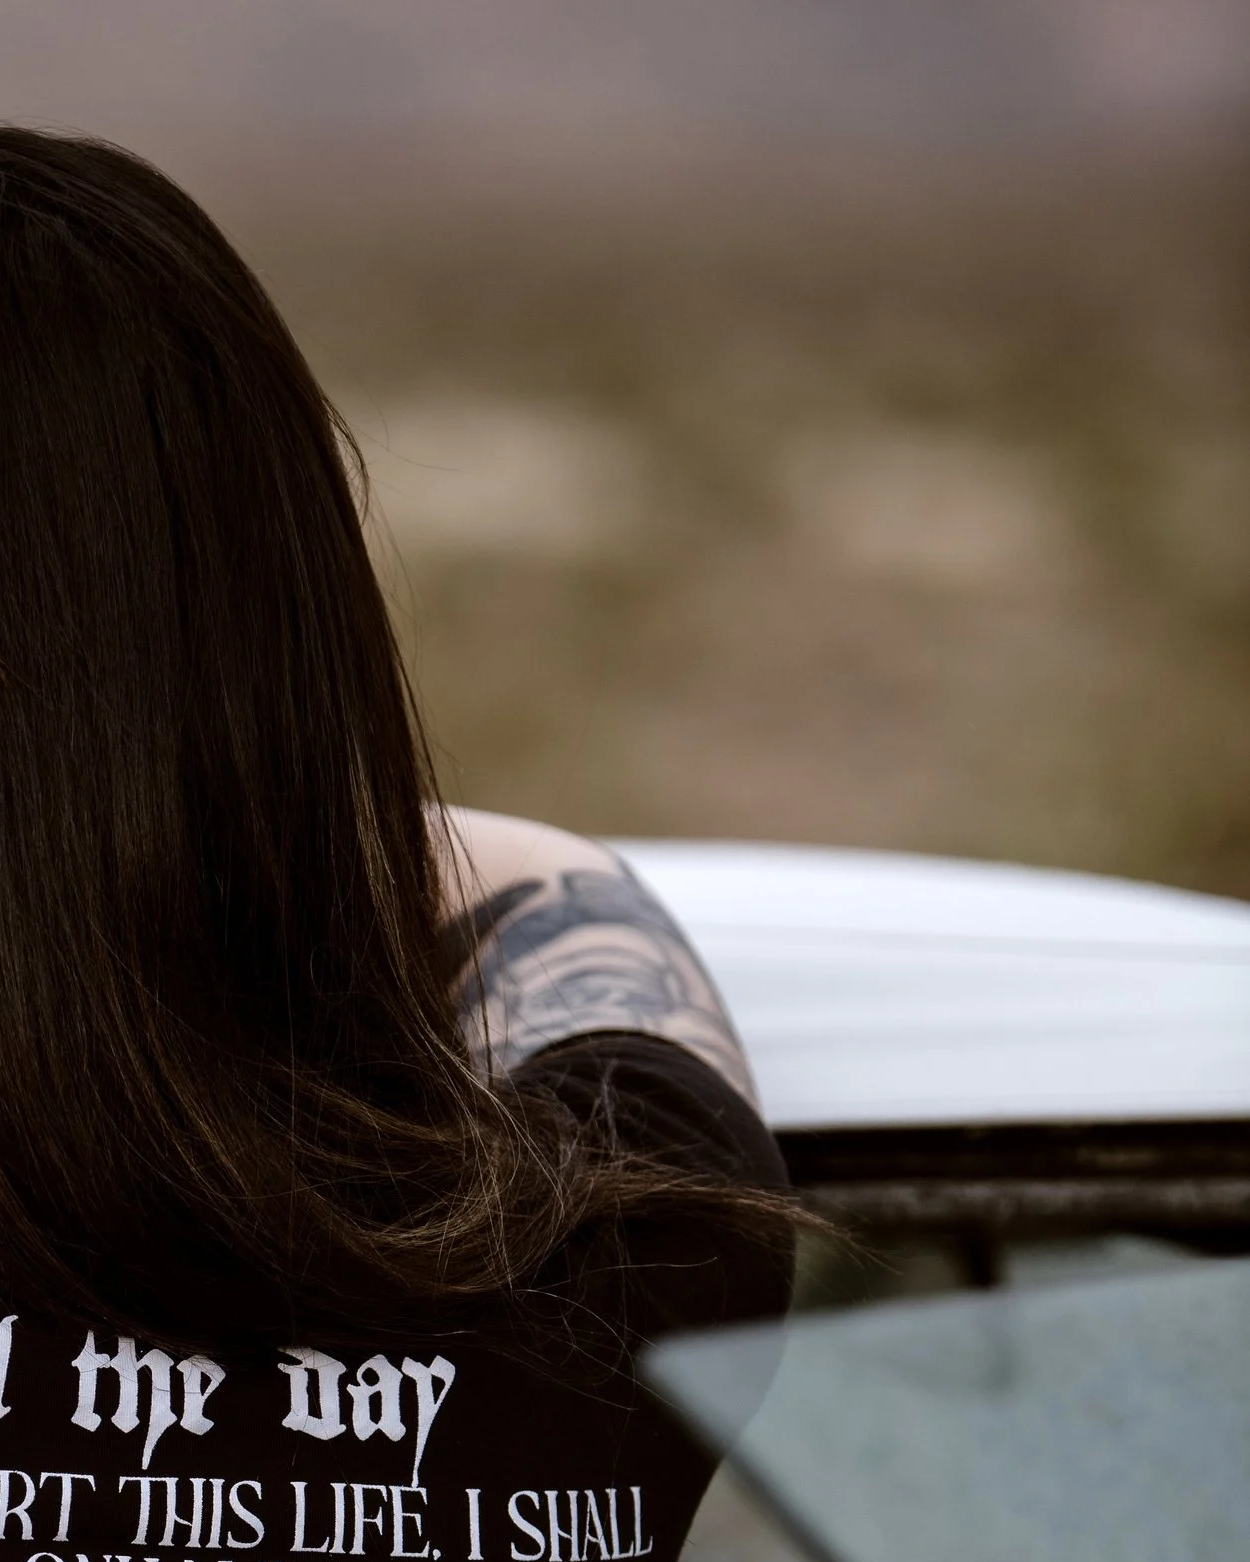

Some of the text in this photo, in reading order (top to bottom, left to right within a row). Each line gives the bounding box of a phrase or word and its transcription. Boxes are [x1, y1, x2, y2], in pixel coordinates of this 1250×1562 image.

[70, 1330, 228, 1471] the
[119, 1476, 264, 1548] THIS
[290, 1481, 441, 1561] LIFE,
[465, 1489, 483, 1560] I
[508, 1487, 652, 1562] SHALL
